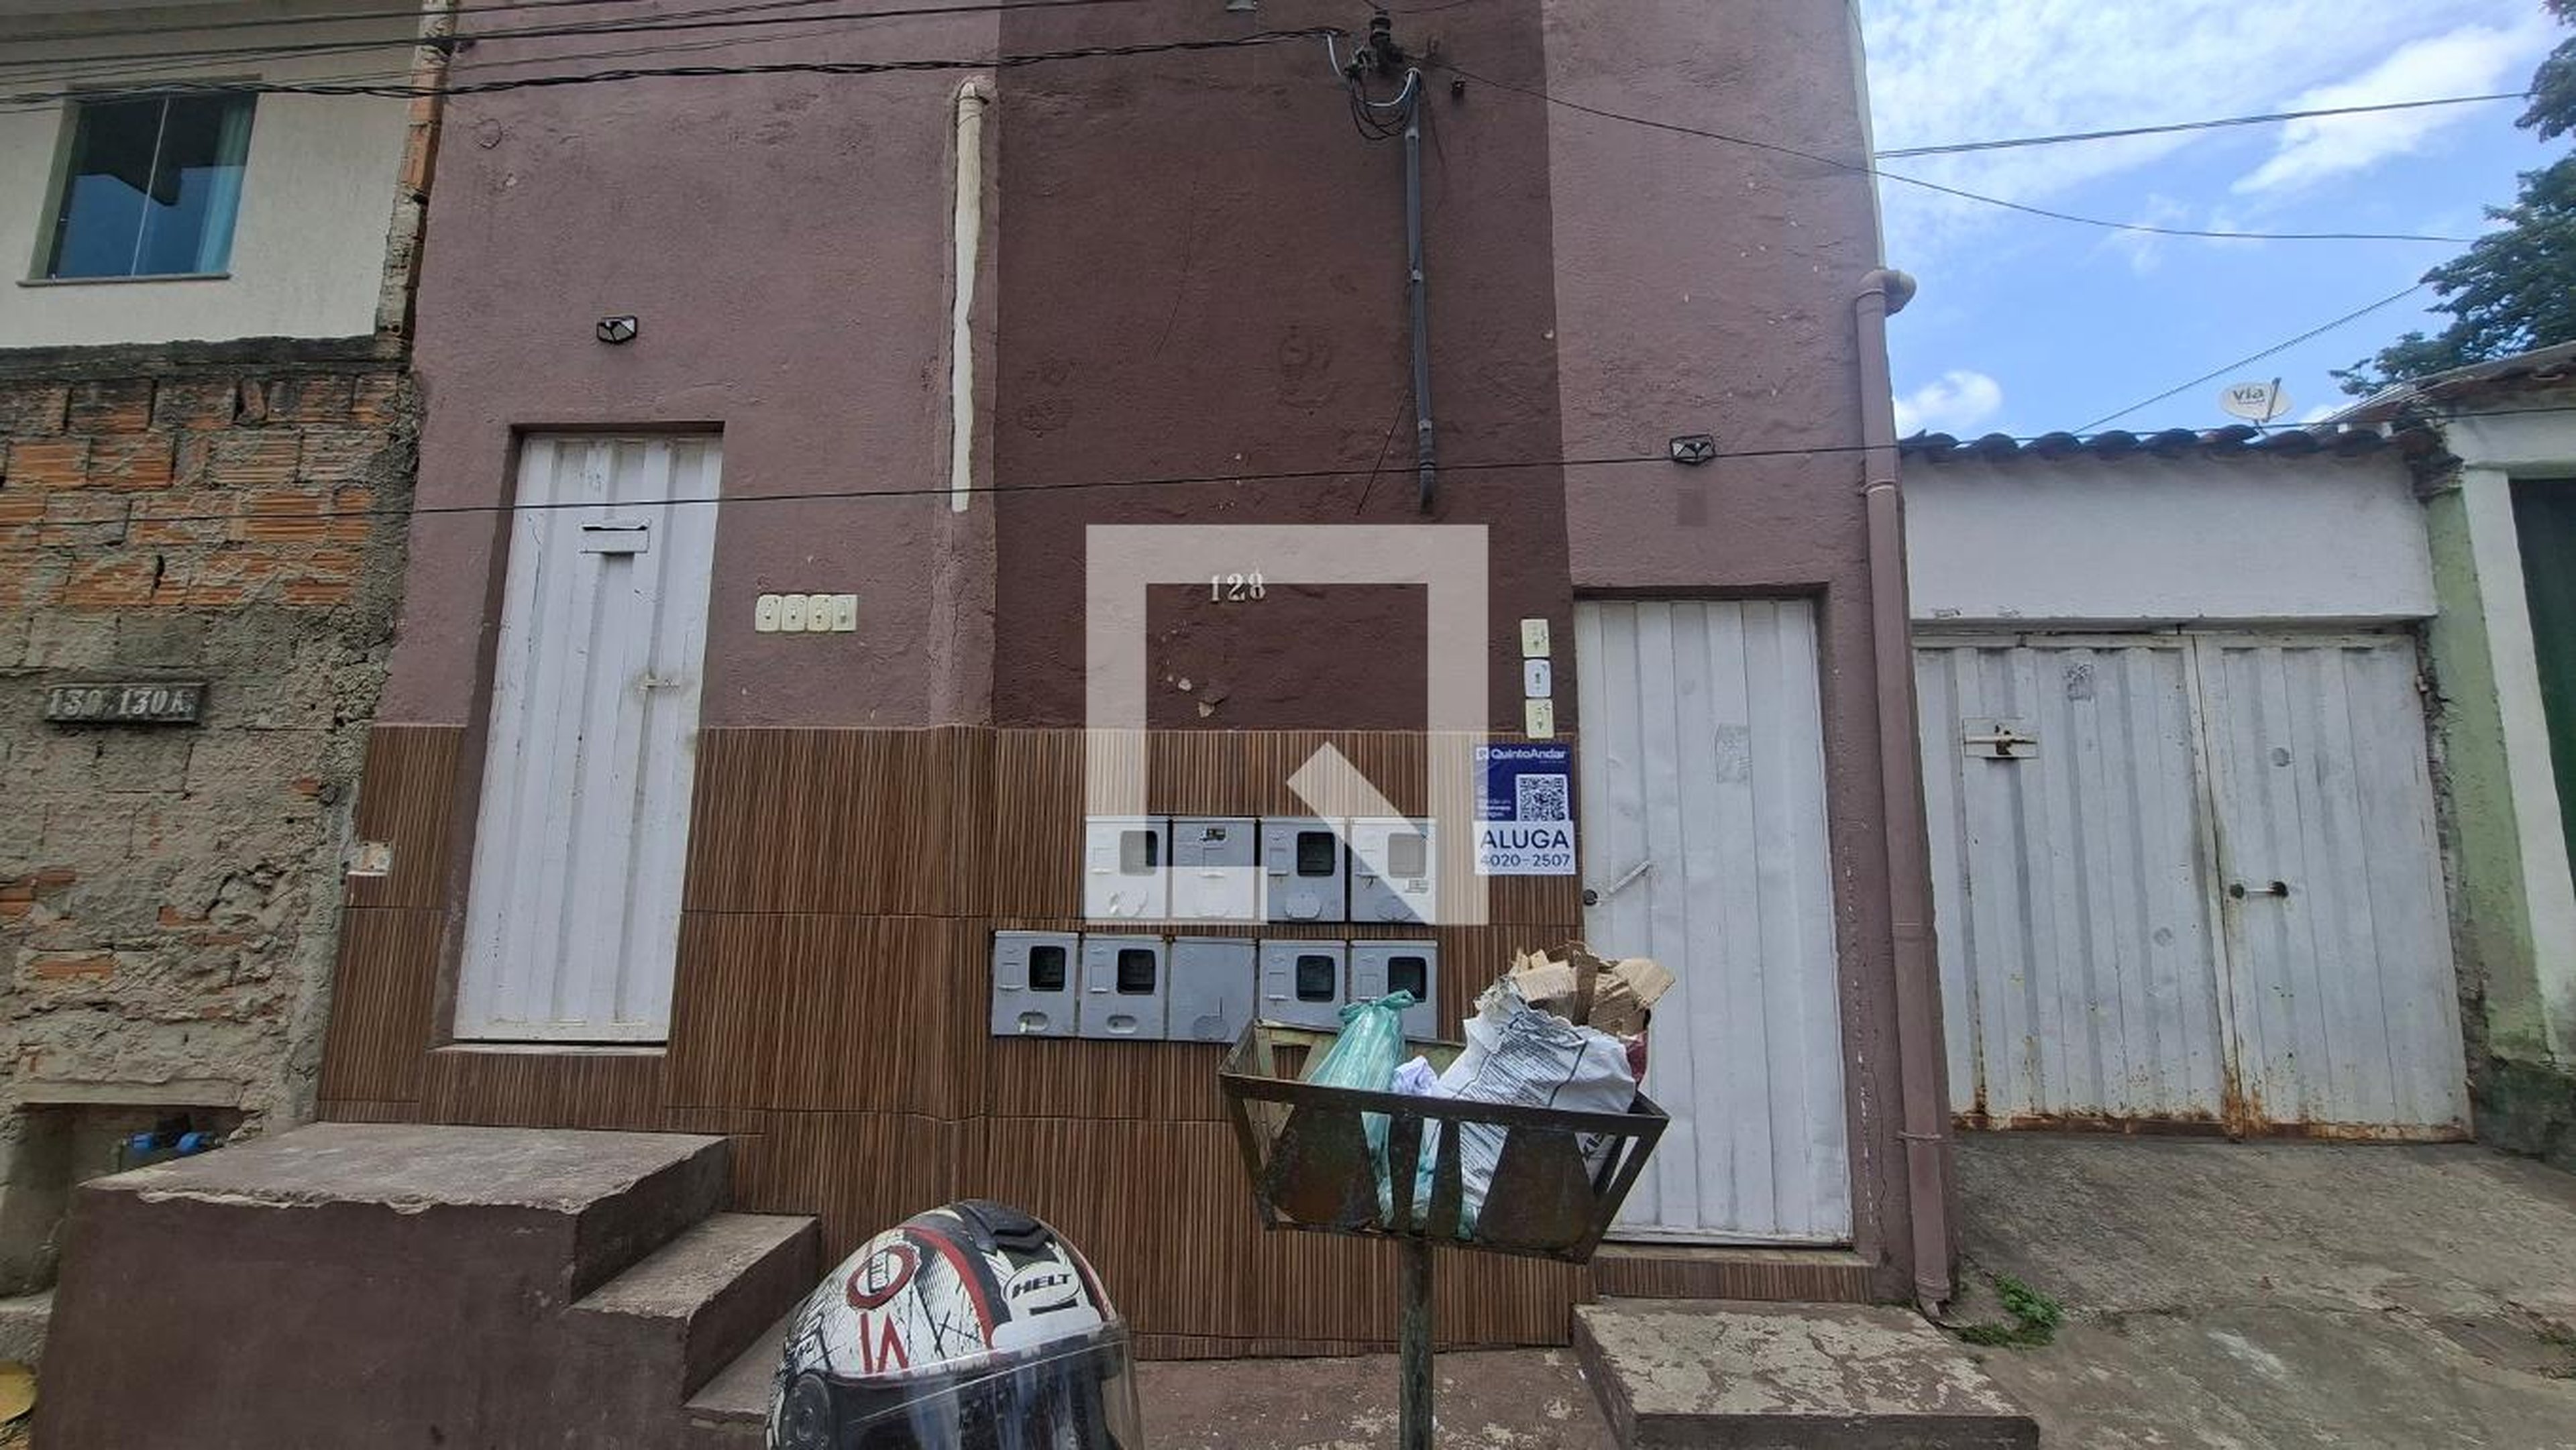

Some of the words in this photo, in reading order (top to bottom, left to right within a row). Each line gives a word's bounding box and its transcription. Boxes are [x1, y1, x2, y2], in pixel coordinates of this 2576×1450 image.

[1212, 573, 1266, 601] 128
[1491, 748, 1566, 759] QuintoAndar
[1481, 830, 1570, 848] ALUGA
[1012, 1274, 1071, 1300] HELT
